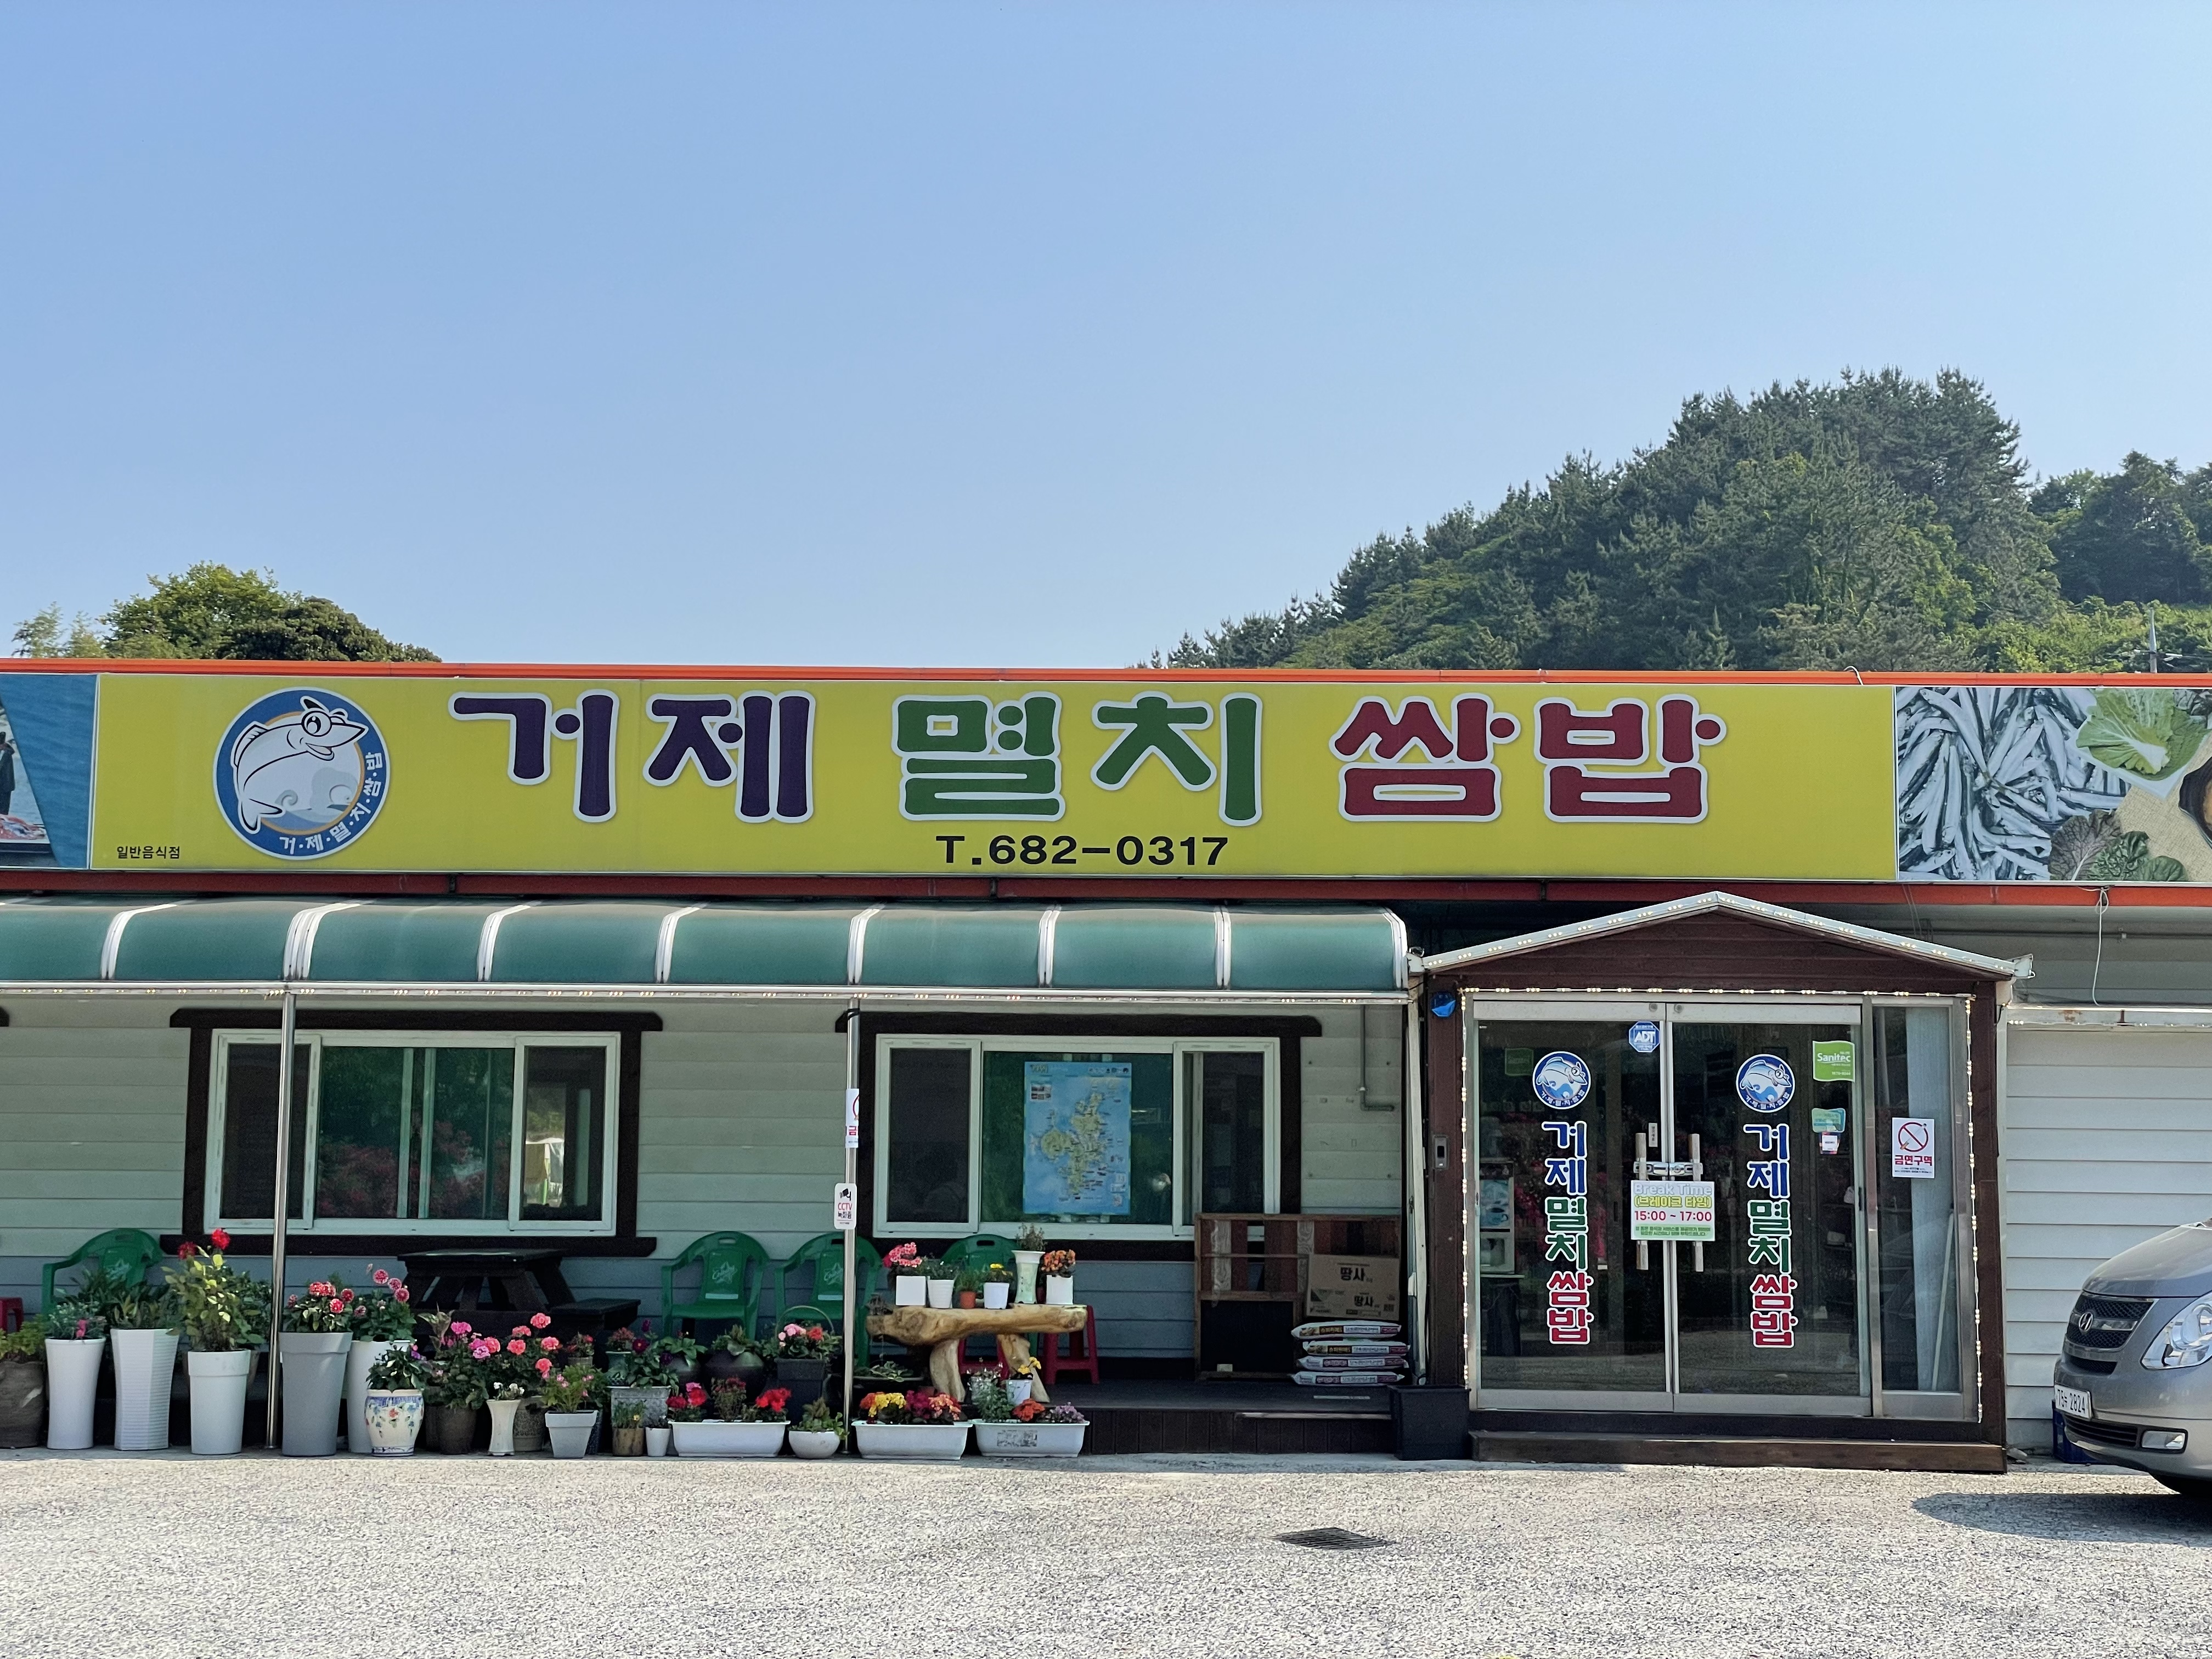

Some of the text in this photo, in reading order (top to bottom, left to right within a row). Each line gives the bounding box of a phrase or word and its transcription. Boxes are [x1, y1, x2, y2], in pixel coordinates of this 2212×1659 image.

[448, 690, 1726, 826] 거제 멸치 쌈밥
[117, 845, 180, 859] 일반음식점
[935, 835, 1228, 866] T.682-0317
[1634, 1031, 1655, 1043] ADT
[1817, 1052, 1851, 1062] Sanitec
[1894, 1155, 1932, 1166] 금연구역
[1634, 1183, 1712, 1195] Break Time
[838, 1203, 852, 1211] CCTV
[1634, 1195, 1712, 1208] (브레이크 타임)
[838, 1211, 851, 1219] 녹화중
[1635, 1211, 1666, 1221] 15:00
[1680, 1211, 1712, 1221] 17:00
[2069, 1392, 2085, 1414] 2824
